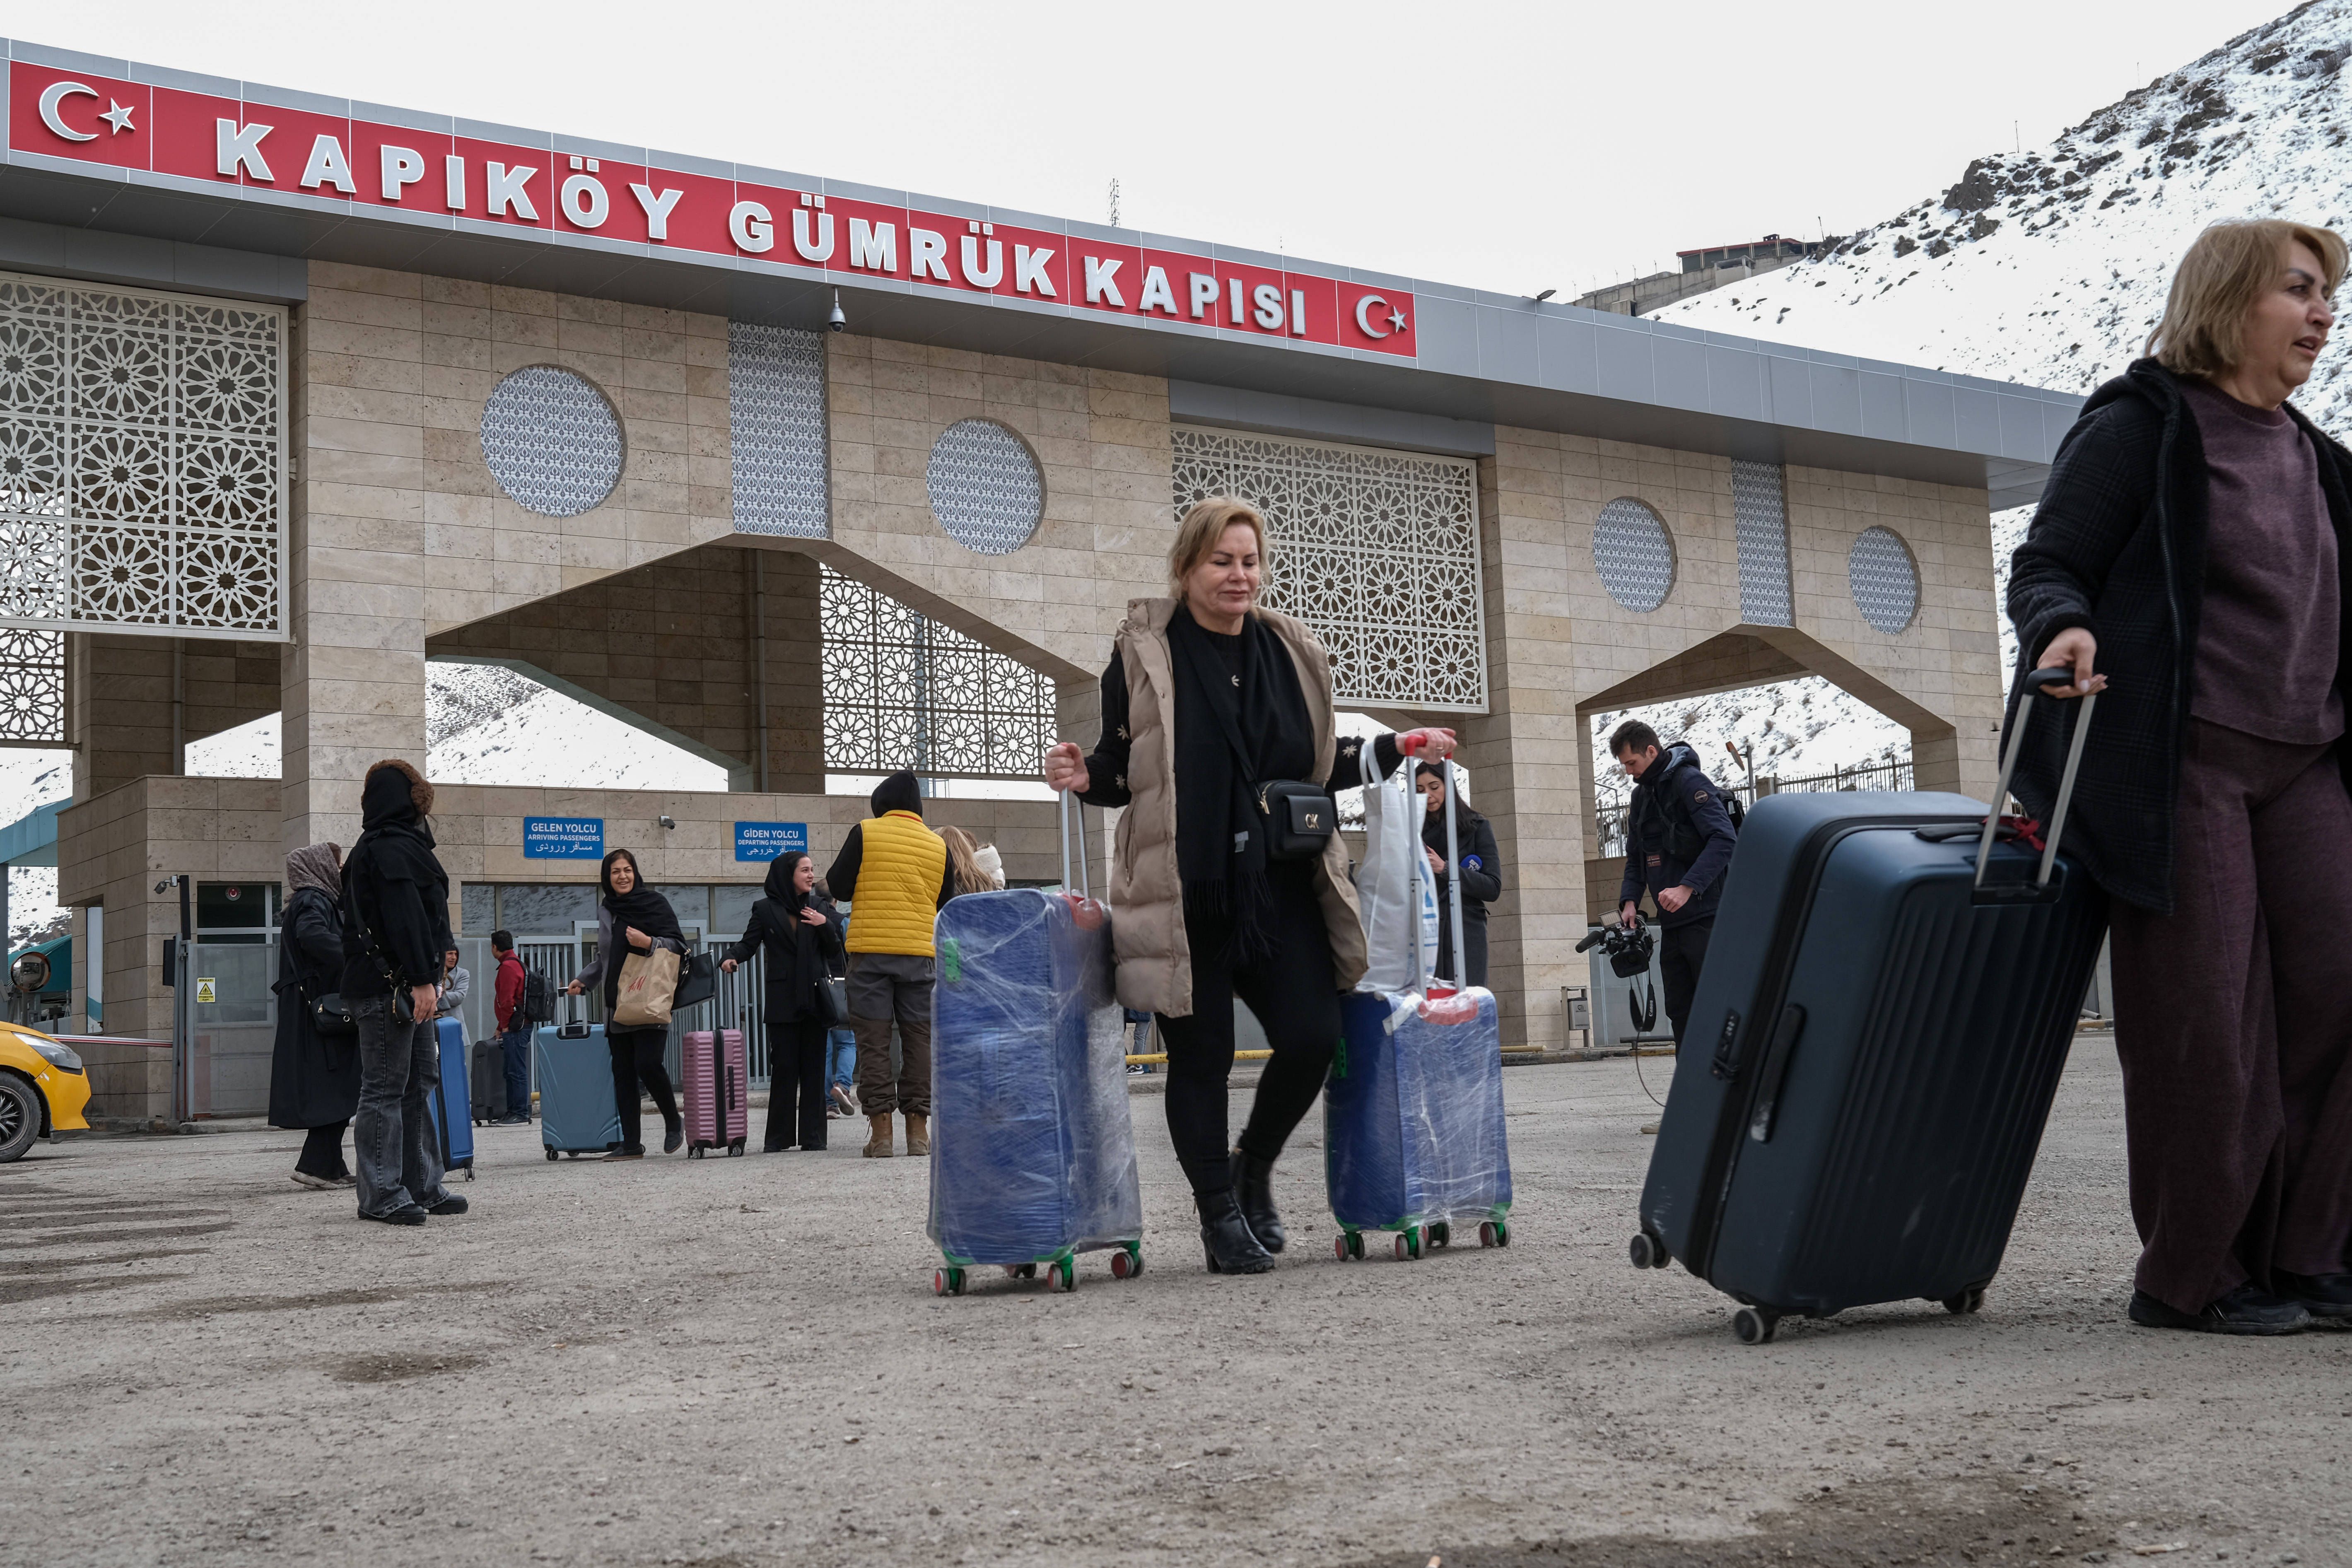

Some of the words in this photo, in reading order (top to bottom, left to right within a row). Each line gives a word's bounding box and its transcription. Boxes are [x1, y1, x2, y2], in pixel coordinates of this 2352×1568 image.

[215, 117, 684, 241] KAPIKÖY
[728, 193, 1058, 297] GÜMRÜK
[1084, 256, 1306, 336] KAPISI
[1305, 813, 1320, 829] CK
[531, 823, 563, 832] GELEN
[565, 824, 596, 833] YOLCU
[743, 828, 770, 838] GİDEN
[772, 830, 798, 838] YOLCU
[569, 842, 593, 853] مسافر
